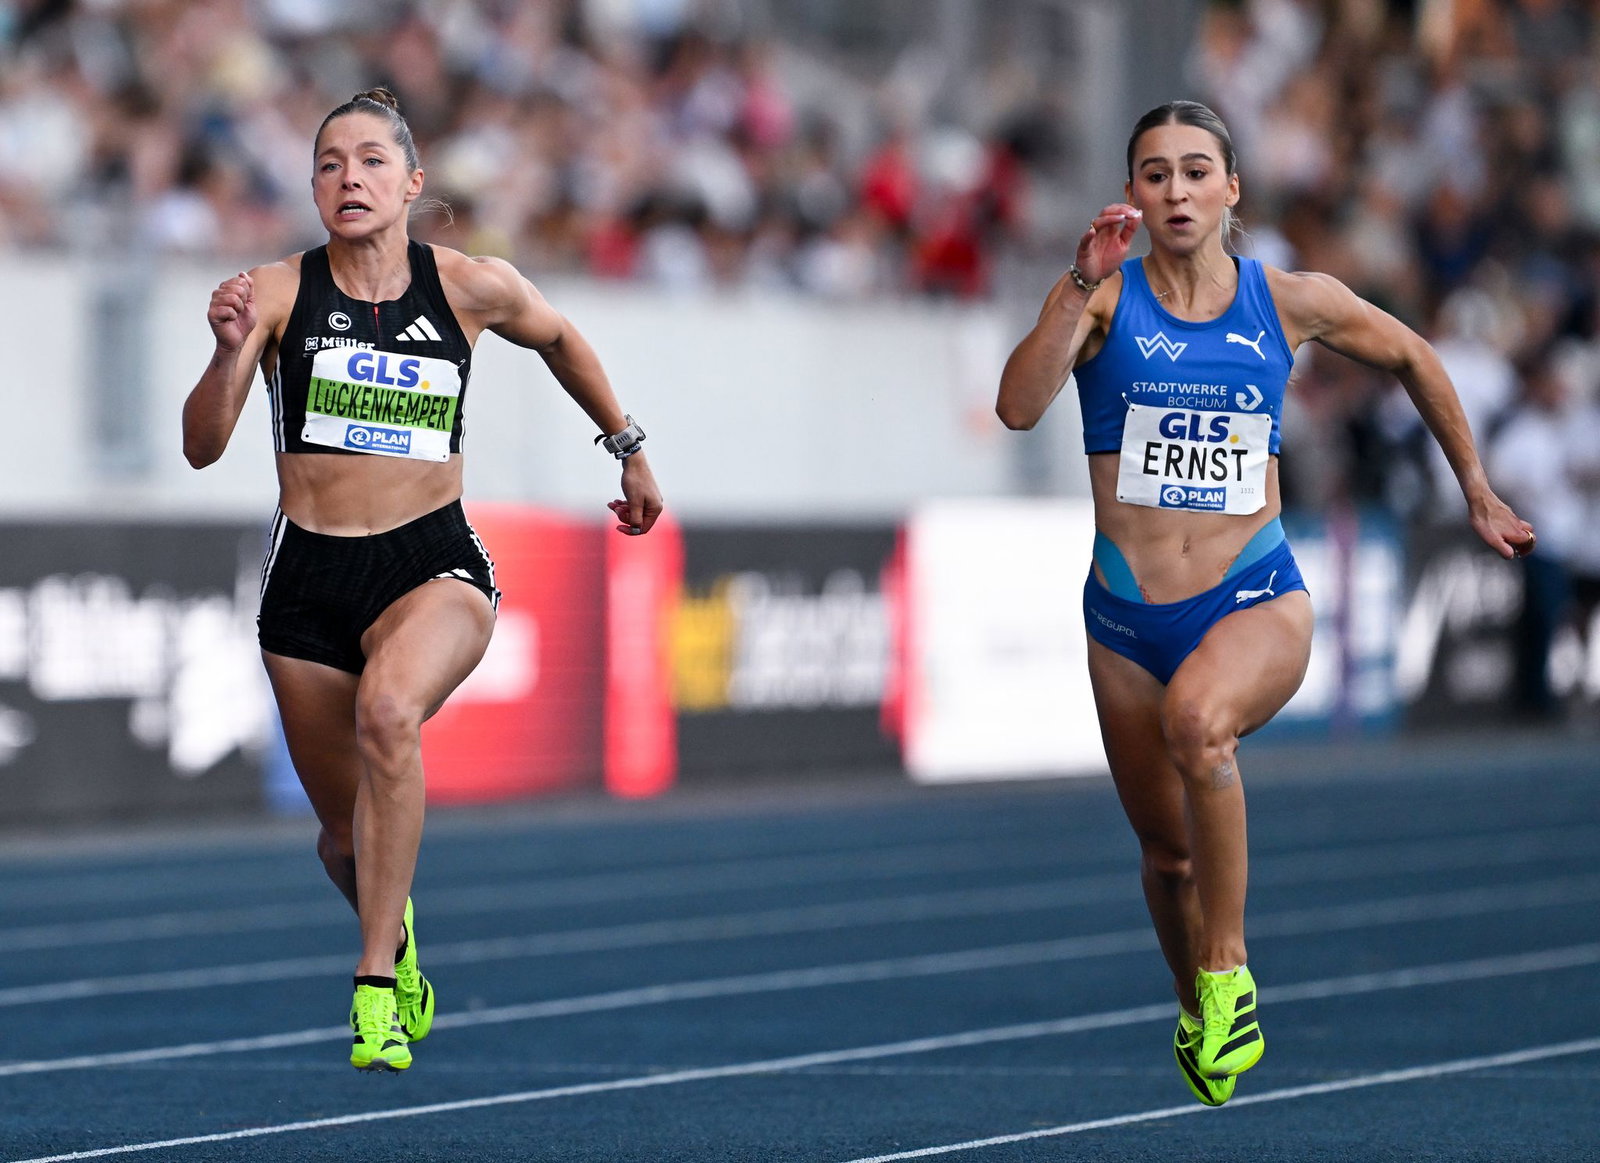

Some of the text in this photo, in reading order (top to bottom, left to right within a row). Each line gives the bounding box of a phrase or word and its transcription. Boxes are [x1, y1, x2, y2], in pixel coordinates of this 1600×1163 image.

[321, 337, 375, 350] Müller
[1132, 382, 1228, 396] STADTWERKE
[313, 379, 449, 430] LÜCKENKEMPER
[1167, 396, 1227, 409] BOCHUM
[372, 431, 409, 446] PLAN
[1142, 441, 1248, 482] ERNST
[1188, 490, 1224, 503] PLAN
